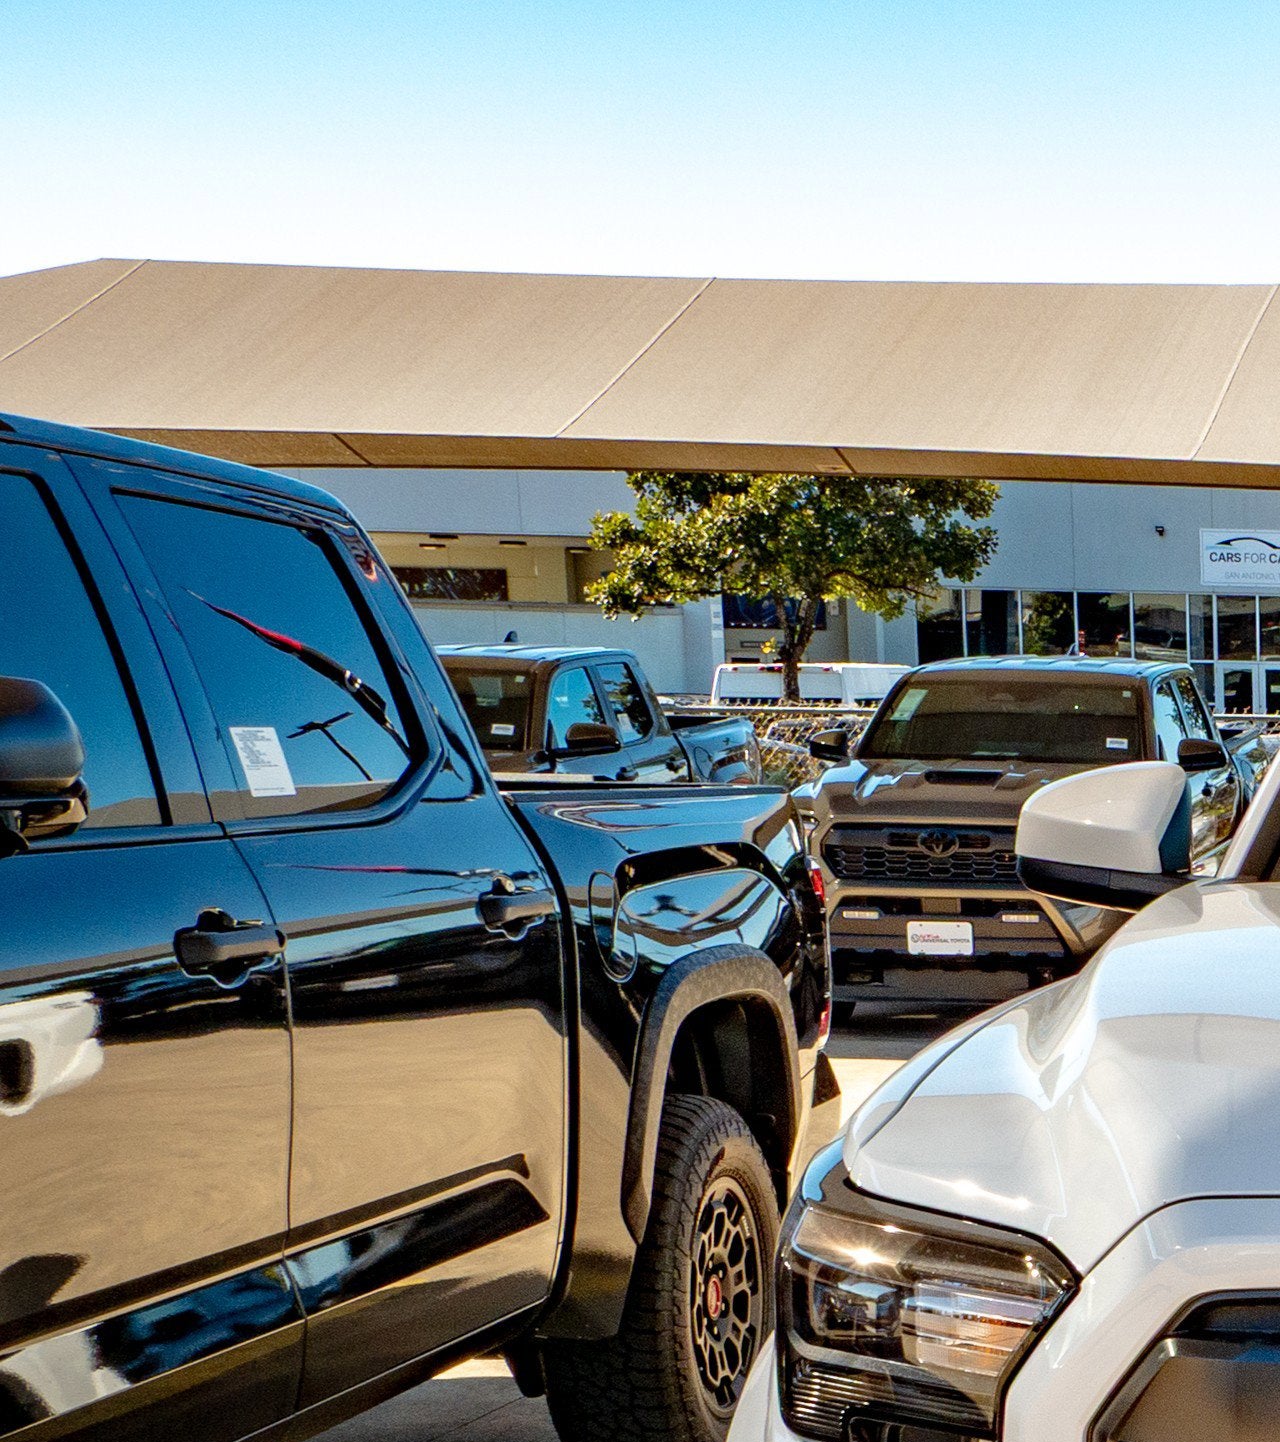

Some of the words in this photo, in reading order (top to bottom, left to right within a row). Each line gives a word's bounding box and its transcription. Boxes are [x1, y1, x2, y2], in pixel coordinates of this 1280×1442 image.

[1209, 551, 1241, 563] CARS
[1244, 552, 1267, 564] FOR
[1224, 572, 1240, 580] SAN
